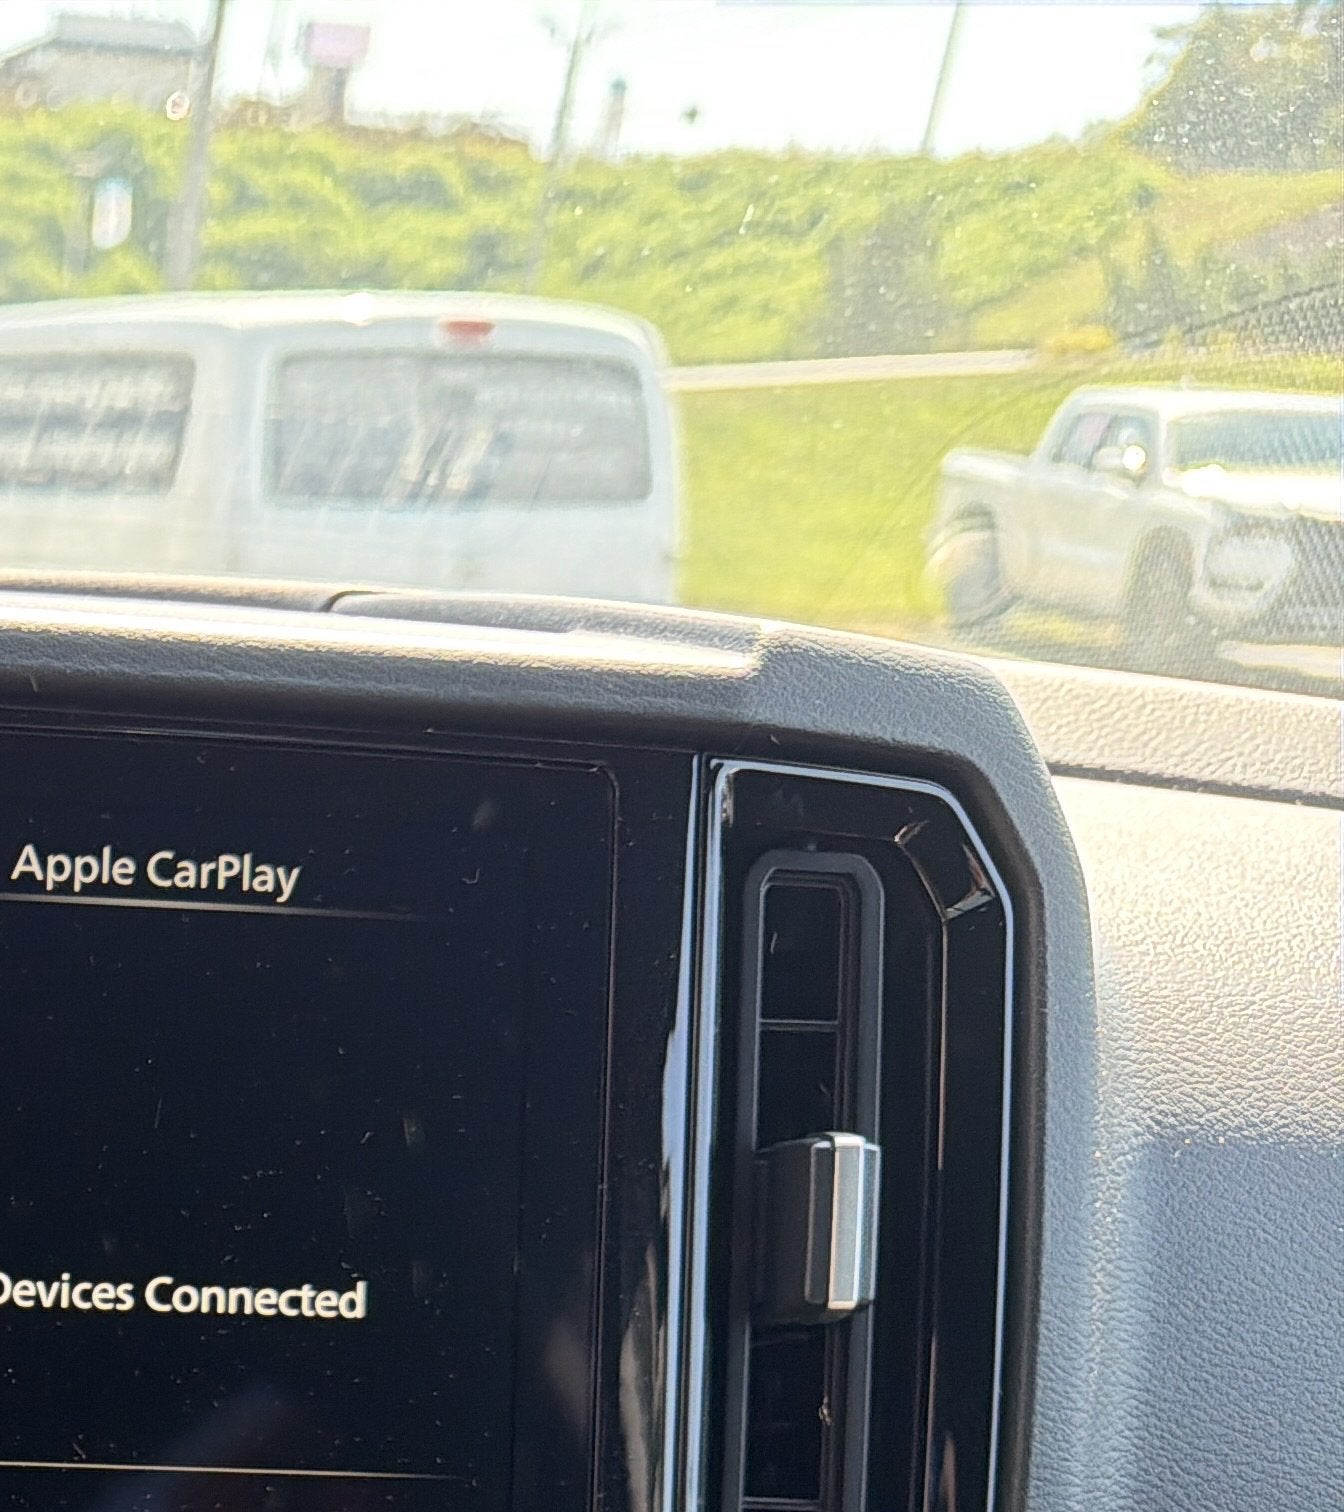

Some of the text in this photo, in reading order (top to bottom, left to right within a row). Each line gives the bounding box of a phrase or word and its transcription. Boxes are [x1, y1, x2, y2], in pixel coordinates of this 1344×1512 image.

[11, 843, 301, 904] Apple CarPlay
[144, 1276, 368, 1320] Connected
